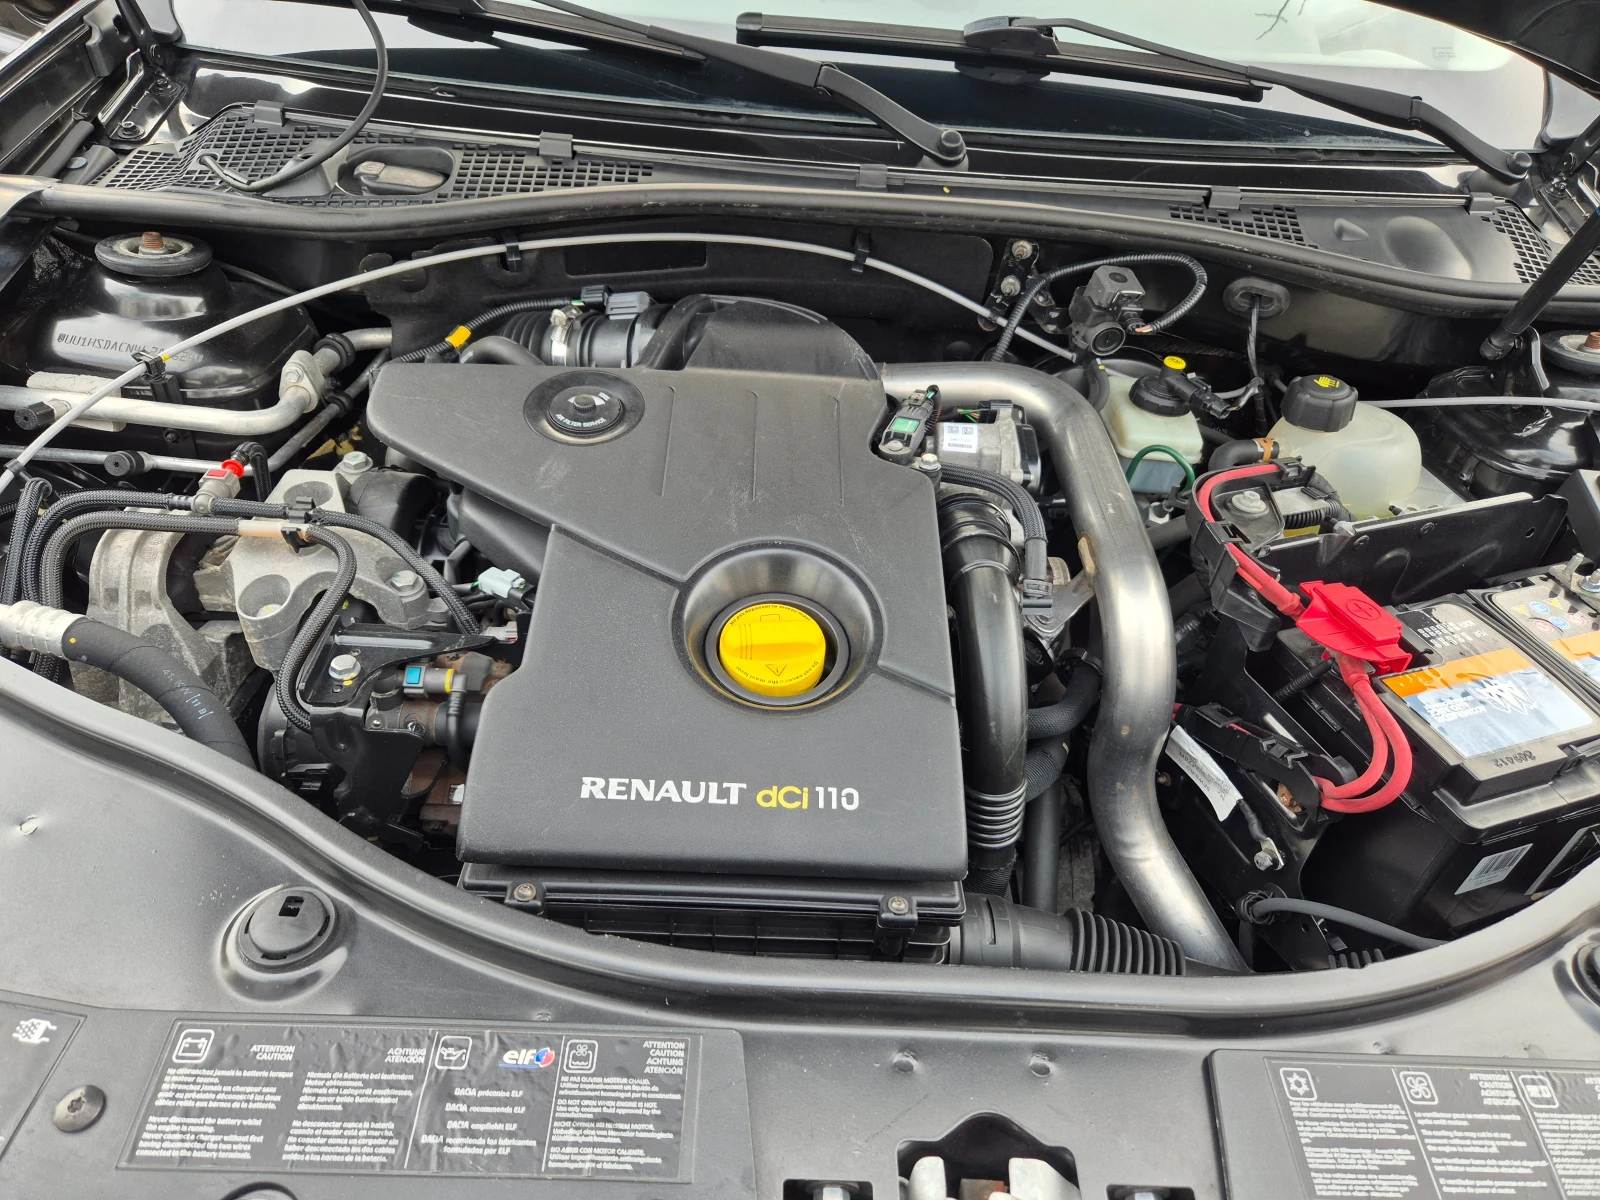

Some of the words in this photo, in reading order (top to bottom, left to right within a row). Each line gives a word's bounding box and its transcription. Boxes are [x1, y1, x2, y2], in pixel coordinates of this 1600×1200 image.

[563, 419, 582, 427] FILTER
[582, 417, 607, 427] SERVICE
[735, 666, 750, 678] level
[580, 776, 746, 805] RENAULT
[756, 786, 808, 809] dCi
[815, 786, 859, 810] 110
[250, 1044, 295, 1053] ATTENTION
[643, 1040, 685, 1049] ATTENTION
[255, 1052, 293, 1060] CAUTION
[387, 1047, 426, 1057] ACHTUNG
[649, 1048, 684, 1057] CAUTION
[384, 1053, 425, 1063] ATENCIÓN
[503, 1049, 536, 1065] elf
[646, 1057, 683, 1066] ACHTUNG
[644, 1065, 683, 1074] ATENCIÓN
